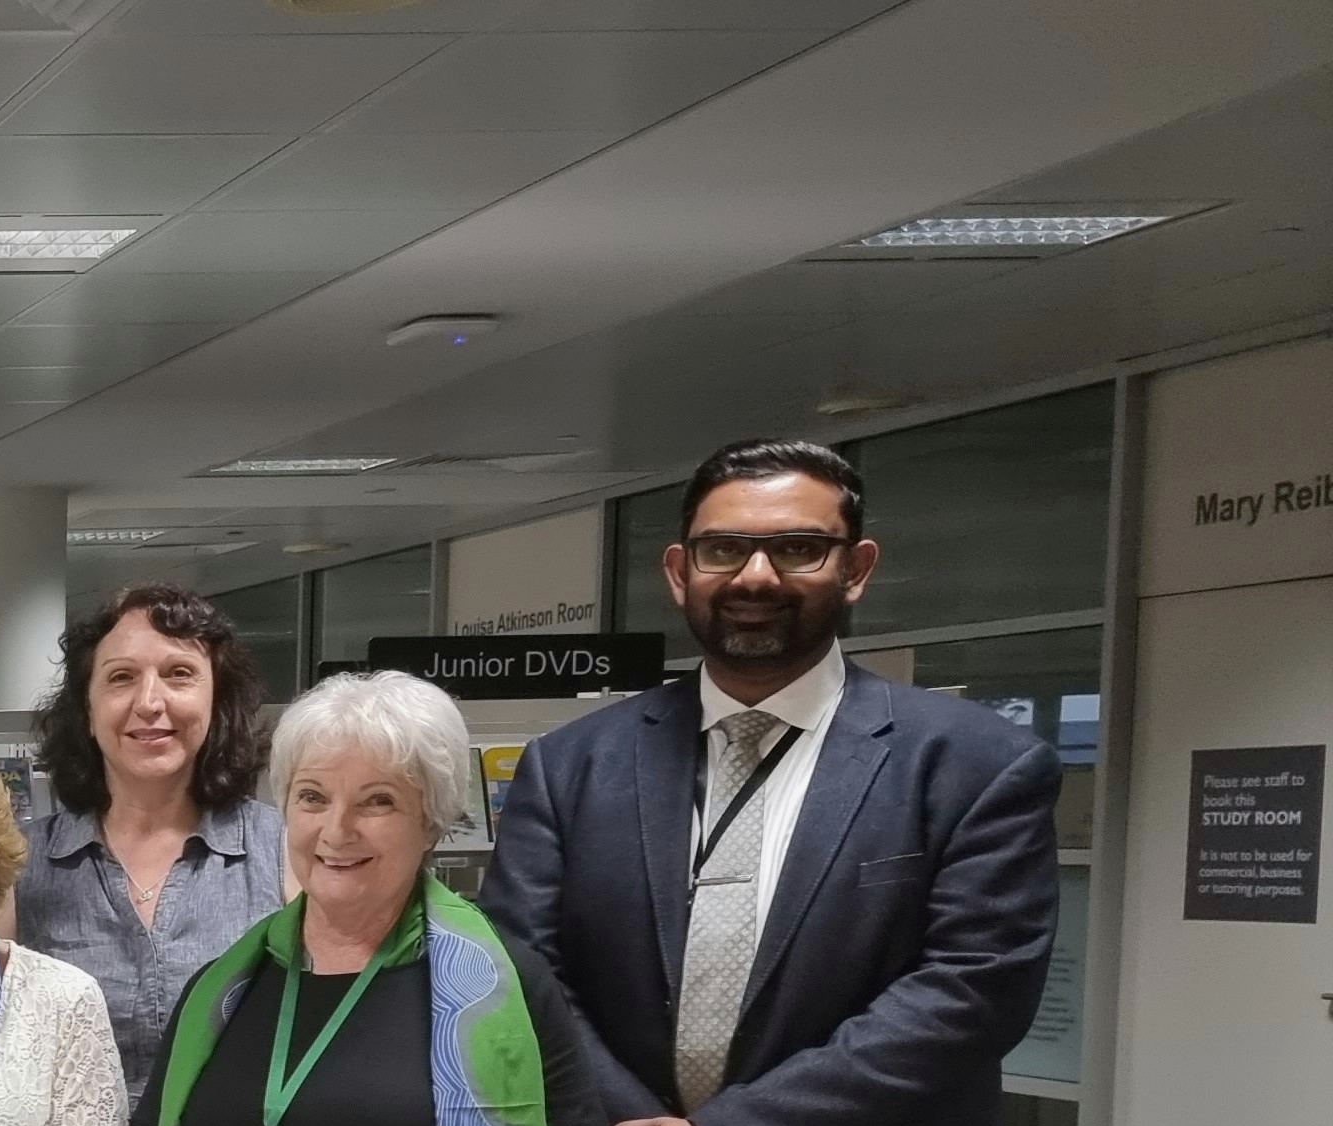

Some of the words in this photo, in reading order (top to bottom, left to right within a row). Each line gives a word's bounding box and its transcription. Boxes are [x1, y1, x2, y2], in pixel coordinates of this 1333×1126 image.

[1195, 493, 1264, 527] Mary
[1274, 474, 1333, 513] Reib
[453, 616, 494, 636] Louisa
[496, 610, 553, 634] Atkinson
[424, 650, 515, 678] Junior
[525, 650, 611, 676] DVDs
[1203, 774, 1238, 788] Please
[1241, 777, 1261, 787] see
[1264, 772, 1290, 787] staff
[1291, 775, 1305, 786] to
[1203, 793, 1232, 807] book
[1234, 792, 1255, 806] this
[1203, 811, 1251, 826] STUDY
[1255, 810, 1302, 825] ROOM
[1210, 850, 1218, 861] is
[1221, 852, 1237, 861] not
[1240, 852, 1252, 861] to
[1255, 849, 1267, 861] be
[1269, 849, 1294, 862] used
[1296, 849, 1313, 862] for
[1259, 866, 1302, 879] business
[1198, 885, 1209, 893] or
